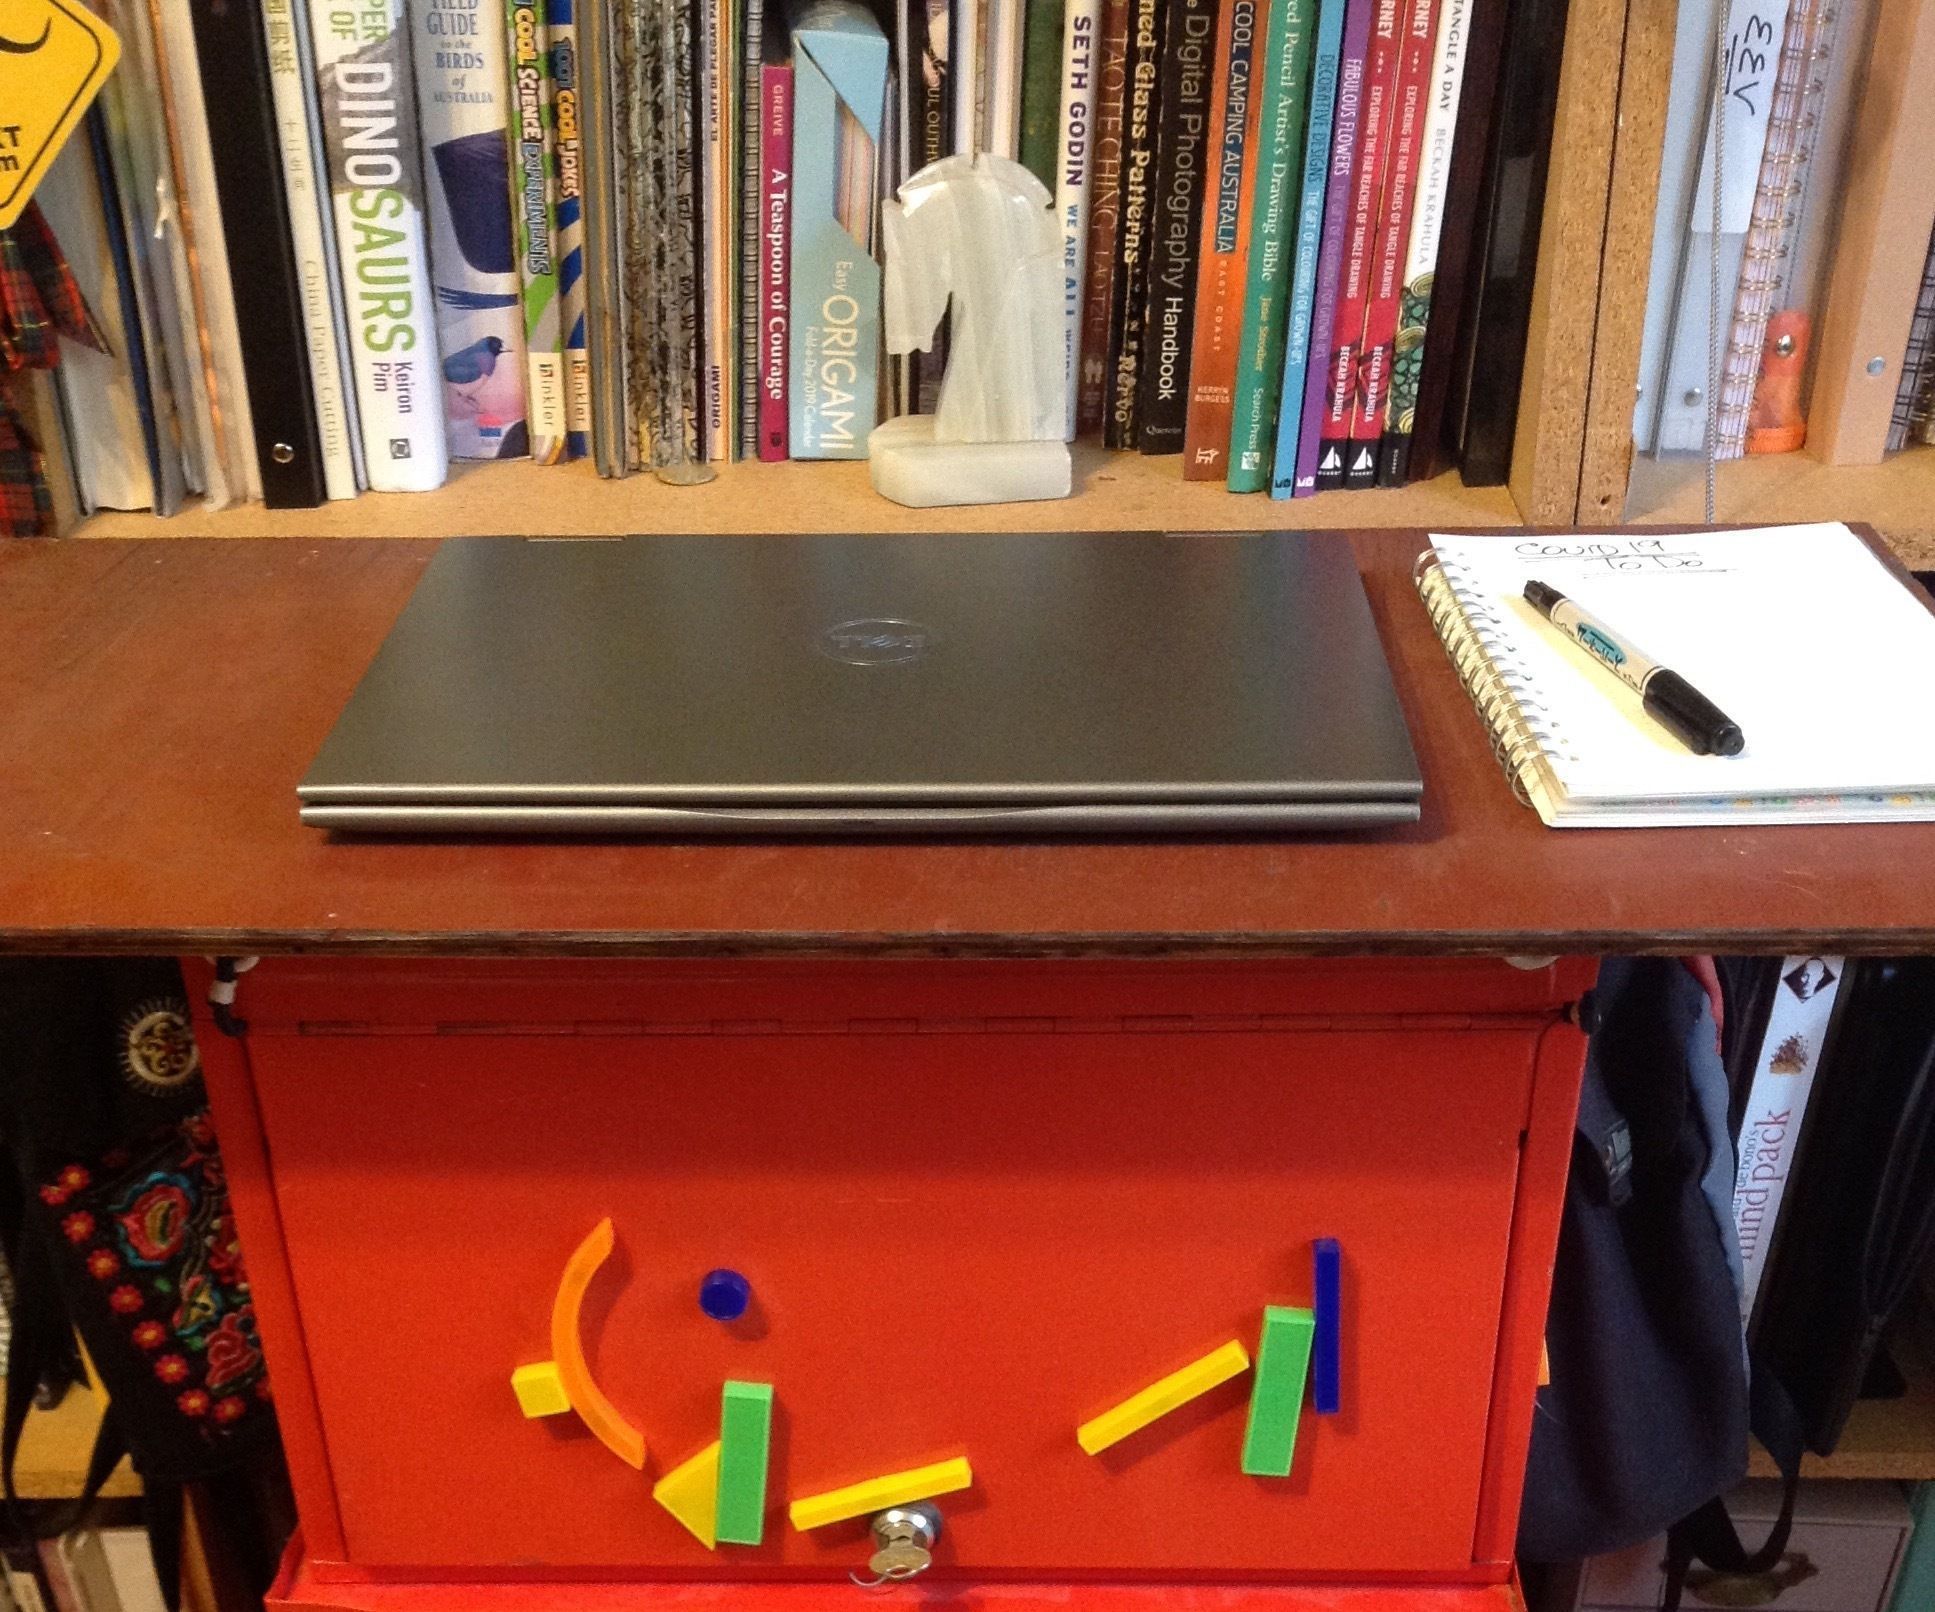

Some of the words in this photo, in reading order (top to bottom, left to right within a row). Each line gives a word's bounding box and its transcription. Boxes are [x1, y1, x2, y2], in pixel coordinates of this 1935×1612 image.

[329, 11, 358, 41] OF
[427, 12, 479, 35] GUIDE
[514, 8, 537, 66] COOL
[1232, 1, 1254, 54] COOL
[1377, 0, 1396, 39] RNEY
[1413, 0, 1432, 39] RNEY
[1446, 0, 1464, 59] TANGLE
[435, 52, 484, 69] BIRDS
[710, 23, 718, 70] PLEGAR
[1072, 16, 1092, 90] SETH
[1102, 37, 1128, 91] TAO
[1176, 15, 1210, 103] Digital
[1280, 32, 1299, 87] Pencil
[452, 75, 466, 90] of
[710, 73, 718, 90] DE
[1338, 59, 1362, 118] FABULOUS
[1444, 64, 1454, 74] A
[433, 91, 494, 103] AUSTRALIA
[517, 66, 544, 143] SCIENCE
[710, 93, 718, 124] ARTE
[771, 84, 785, 137] GREIVE
[1131, 62, 1156, 139] Glass
[1225, 60, 1249, 145] CAMPING
[1313, 54, 1335, 130] DECORATIVE
[1366, 86, 1383, 136] EXPLORING
[1400, 86, 1418, 136] EXPLORING
[1439, 81, 1453, 112] DAY
[555, 89, 578, 142] COOL
[710, 128, 718, 142] EL
[1098, 101, 1124, 131] TE
[1274, 93, 1293, 155] Artist's
[0, 126, 21, 149] T
[1066, 101, 1088, 186] GODIN
[1307, 132, 1327, 183] DESIGNS
[1333, 122, 1355, 176] FLOWERS
[1364, 138, 1377, 153] THE
[1398, 138, 1411, 153] THE
[1428, 127, 1447, 189] BECKAH
[556, 139, 580, 198] JOKES
[771, 168, 788, 185] A
[1092, 137, 1122, 229] CHING
[1361, 155, 1375, 173] FAR
[1396, 155, 1410, 173] FAR
[335, 62, 416, 353] DINOSAURS
[522, 142, 551, 275] EXPERIMENTS
[1123, 150, 1150, 264] Patterns
[1161, 113, 1203, 289] Photography
[1216, 150, 1242, 253] AUSTRALIA
[1261, 163, 1287, 234] Drawing
[1306, 191, 1320, 207] THE
[1356, 174, 1372, 211] REACHES
[1390, 174, 1406, 211] REACHES
[1066, 204, 1079, 228] WE
[1304, 209, 1318, 229] GIFT
[1355, 213, 1367, 224] OF
[1390, 213, 1401, 224] OF
[1418, 194, 1436, 265] KRAHULA
[766, 189, 787, 285] Teaspoon
[1065, 236, 1077, 267] ARE
[1303, 231, 1315, 243] OF
[1351, 226, 1366, 257] TANGLE
[1385, 226, 1400, 257] TANGLE
[832, 260, 854, 291] Easy
[1217, 260, 1229, 296] EAST
[1261, 241, 1280, 282] Bible
[1298, 246, 1314, 293] COLOURING
[1346, 259, 1361, 298] DRAWING
[1379, 259, 1394, 298] DRAWING
[305, 259, 321, 318] China
[771, 291, 787, 312] of
[1296, 295, 1309, 311] FOR
[1157, 297, 1184, 400] Handbook
[1213, 306, 1225, 352] COAST
[1290, 313, 1307, 365] GROWN-UPS
[311, 325, 330, 377] Paper
[766, 316, 787, 400] Courage
[819, 294, 859, 449] ORIGAMI
[1335, 346, 1351, 380] BECKAH
[1369, 346, 1384, 380] BECKAH
[371, 362, 393, 392] Pim
[394, 362, 415, 414] Keiron
[711, 364, 721, 429] ORIGAMI
[320, 386, 340, 458] Cutting
[1251, 387, 1265, 422] Search
[1331, 382, 1347, 422] KRAHULA
[1364, 382, 1381, 422] KRAHULA
[1248, 424, 1261, 450] Press
[1629, 539, 1665, 553] 19
[1652, 555, 1703, 569] Do
[1752, 1110, 1792, 1182] pack
[1736, 1188, 1769, 1260] mind
